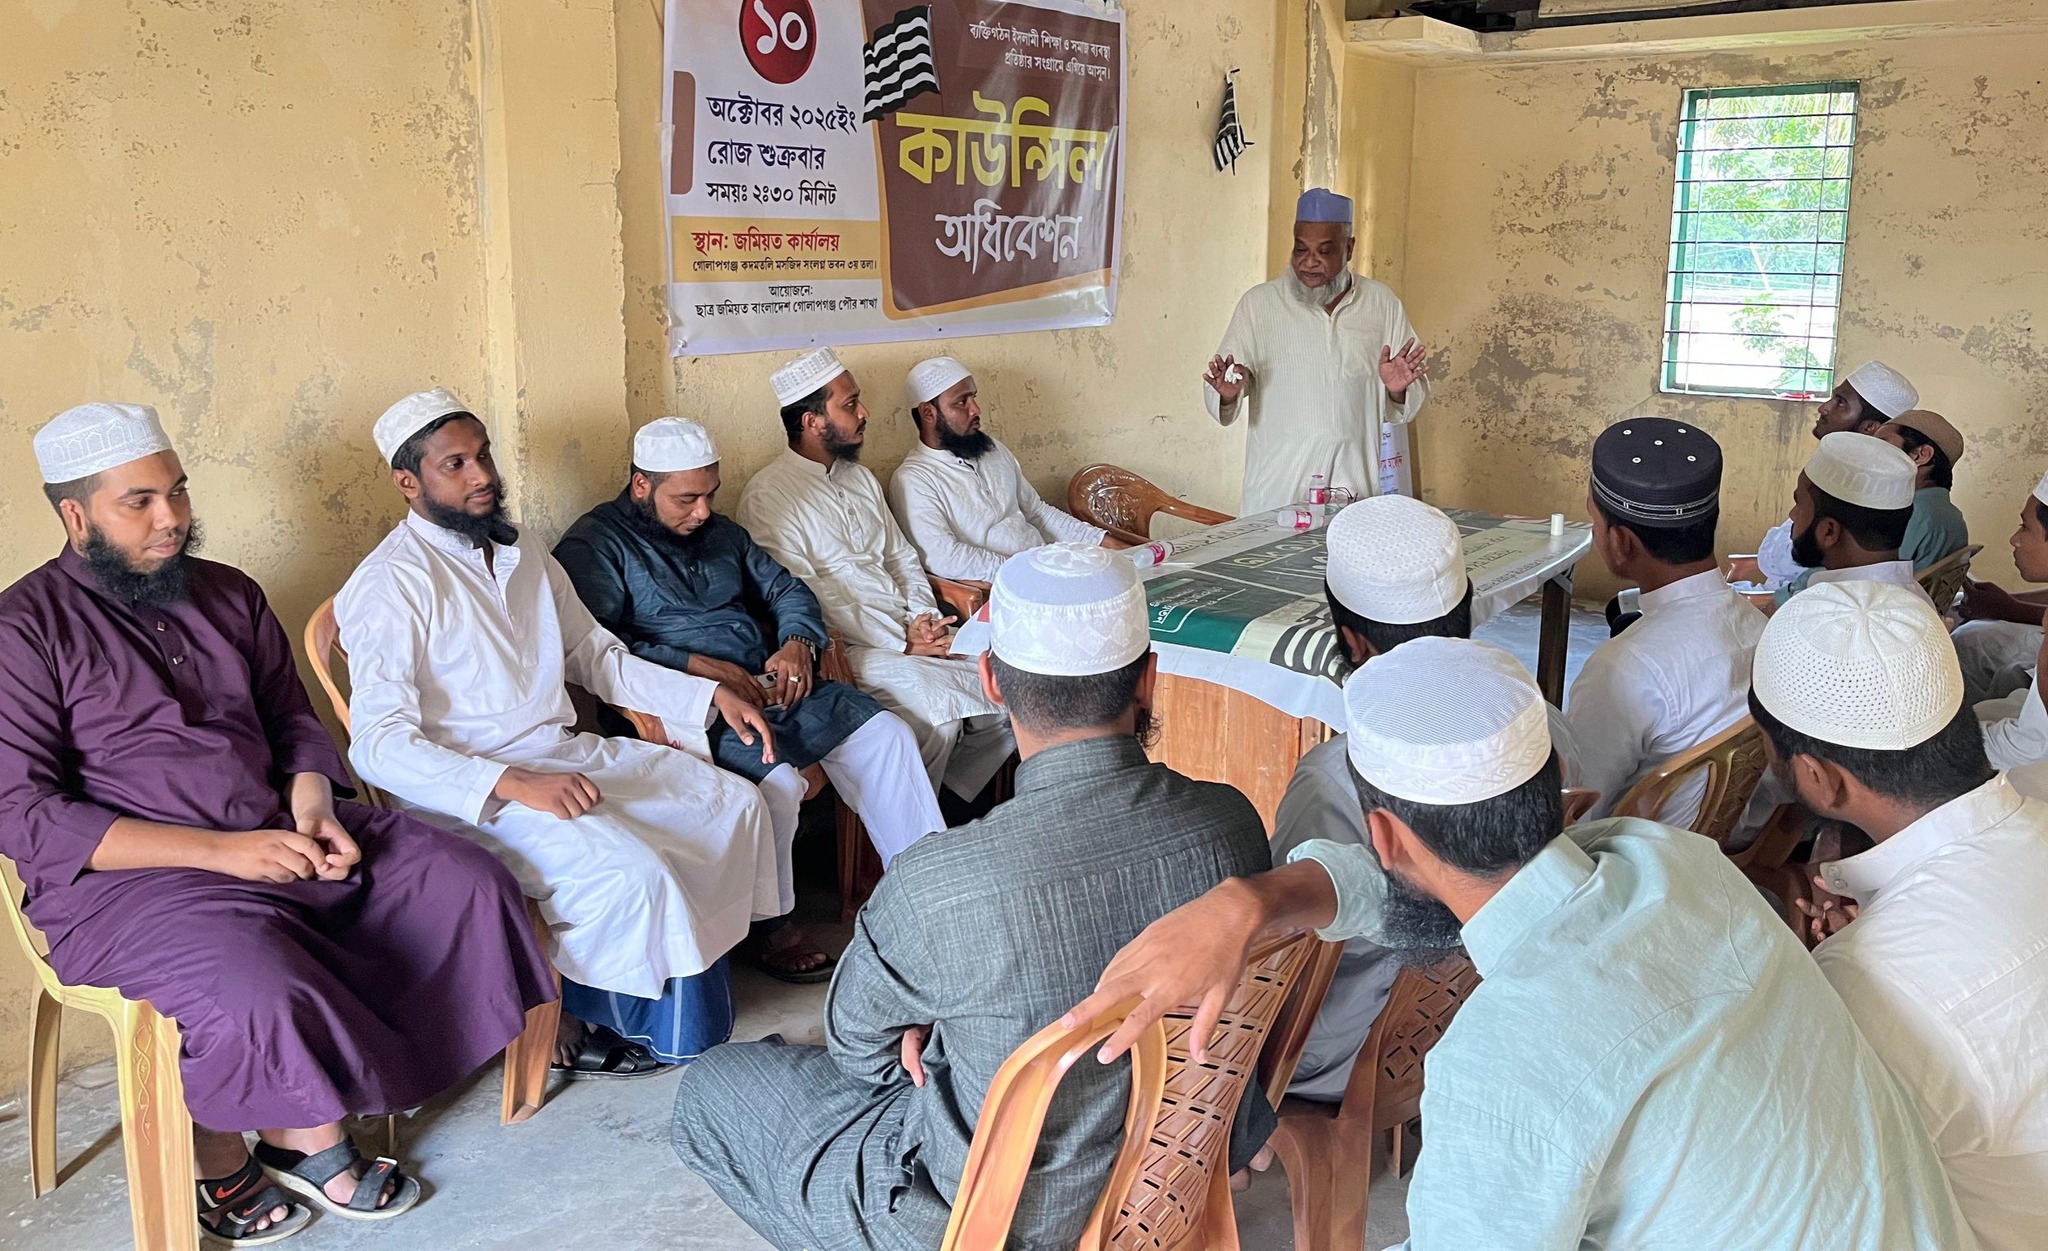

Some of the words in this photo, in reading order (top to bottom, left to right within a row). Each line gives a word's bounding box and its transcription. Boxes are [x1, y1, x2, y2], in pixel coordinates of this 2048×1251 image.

[753, 0, 808, 54] ১০
[1012, 25, 1039, 48] ইসলামী
[1041, 30, 1062, 51] শিক্ষা
[1064, 39, 1070, 51] ও
[1005, 48, 1033, 69] প্রতিষ্ঠার
[1034, 56, 1064, 72] সংগ্রামে
[1065, 57, 1085, 76] এগিয়ে
[705, 91, 784, 126] অক্টোবর
[790, 101, 857, 136] ২০২৫ইং
[708, 138, 753, 167] রোজ
[757, 143, 826, 170] শুক্রবার
[896, 91, 1108, 190] কাউন্সিল
[798, 179, 837, 206] মিনিট
[691, 230, 728, 257] স্থান:
[732, 226, 783, 252] জমিয়ত
[786, 227, 840, 252] কার্যালয়
[935, 198, 1083, 275] অধিবেশন
[693, 259, 739, 273] গোলাপগঞ্জ
[740, 256, 774, 271] কদমতলি
[775, 256, 801, 270] মসজিদ
[803, 259, 826, 270] সংলগ্ন
[828, 259, 846, 270] ভবন
[848, 260, 858, 270] ৩য়
[768, 284, 813, 298] আয়োজনে:
[695, 303, 714, 318] ছাত্র
[716, 299, 749, 316] জমিয়ত
[751, 301, 791, 314] বাংলাদেশ
[793, 299, 836, 313] গোলাপগঞ্জ
[839, 296, 857, 310] পৌর
[859, 297, 878, 309] শাখা
